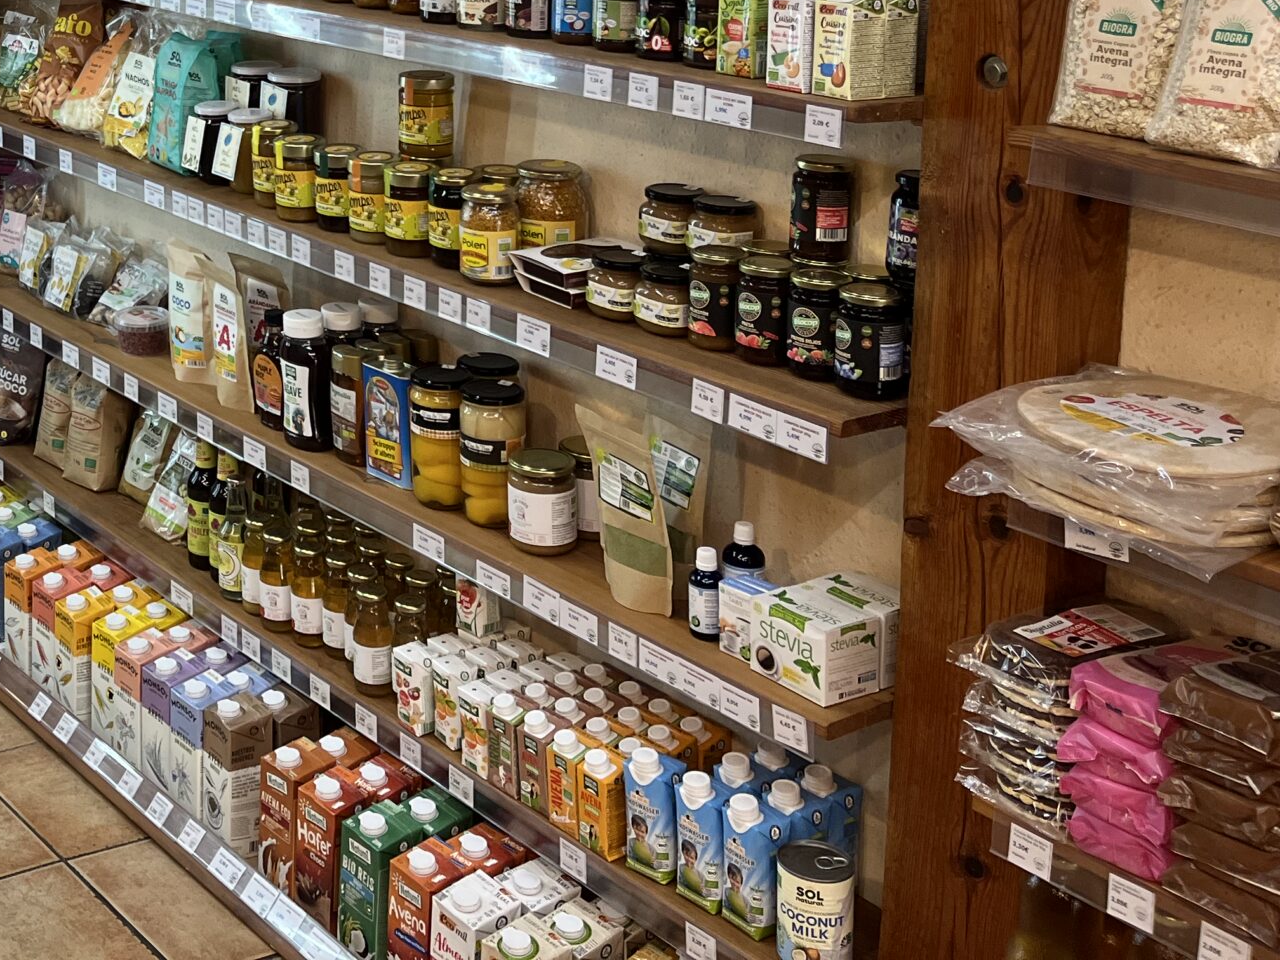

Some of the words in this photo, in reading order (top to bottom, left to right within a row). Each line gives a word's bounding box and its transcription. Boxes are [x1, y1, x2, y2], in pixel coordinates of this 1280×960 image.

[1101, 20, 1135, 36] BIOGRA
[1213, 29, 1250, 45] BIOGRA
[1095, 44, 1130, 58] Avena
[1089, 52, 1134, 69] integral
[1205, 53, 1243, 68] Avena
[124, 71, 151, 87] NACHOS
[1198, 62, 1247, 79] integral
[462, 239, 487, 252] Polen
[171, 294, 191, 311] COCO
[1, 333, 21, 348] SOL
[1104, 399, 1204, 436] ESPELTA
[758, 617, 814, 661] stevia
[829, 633, 862, 653] stevia
[549, 768, 564, 811] AVENA
[260, 790, 280, 815] AVENA
[580, 789, 603, 809] AVENA
[296, 818, 332, 856] Hafer
[342, 854, 356, 875] BIO
[356, 868, 375, 891] REIS
[795, 896, 825, 907] natural
[796, 885, 825, 902] SOL
[388, 895, 428, 937] Avena
[779, 902, 846, 927] COCONUT
[790, 923, 830, 939] MILK
